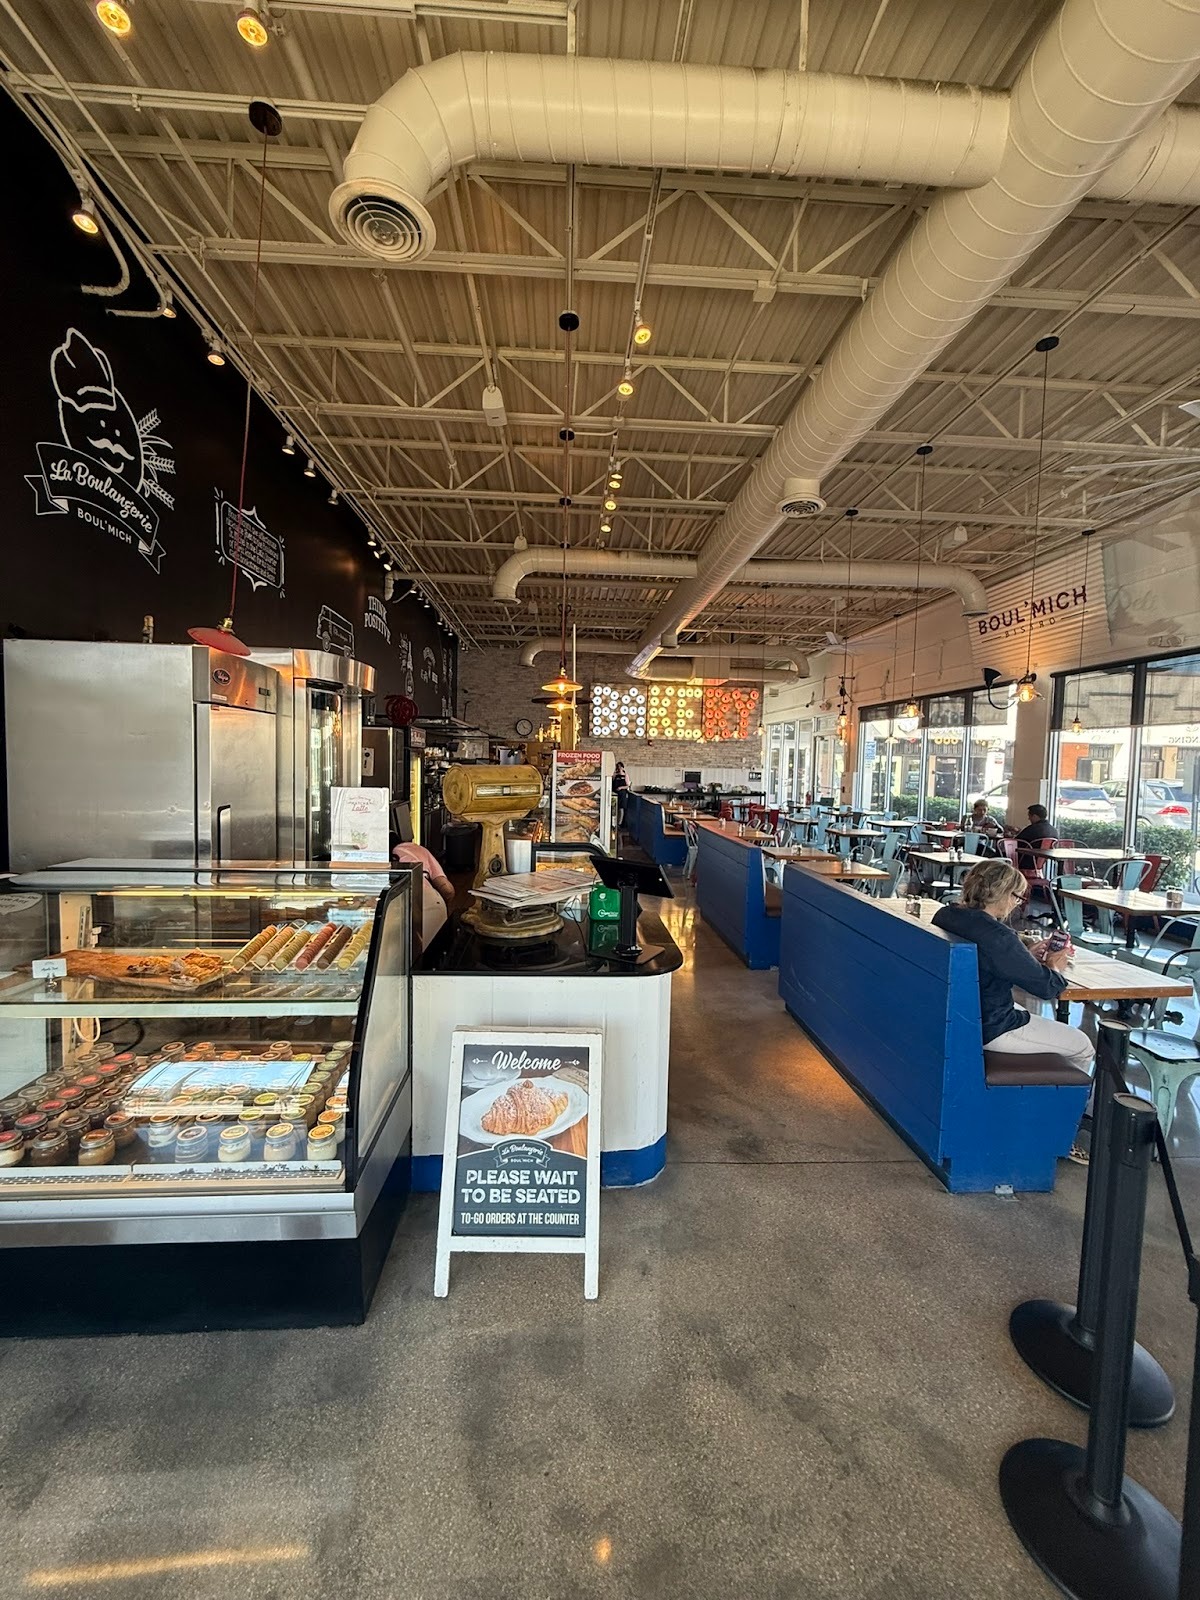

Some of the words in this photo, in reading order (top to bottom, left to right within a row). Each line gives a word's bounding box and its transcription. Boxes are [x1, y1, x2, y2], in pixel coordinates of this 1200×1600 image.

[50, 459, 73, 481] La
[72, 461, 153, 533] Boulangerie
[77, 507, 132, 545] BOUL'MICH
[368, 596, 388, 623] THINK
[978, 585, 1087, 635] BOUL'MICH
[364, 613, 391, 644] POSITIVE
[1004, 617, 1056, 638] BISTRO
[592, 685, 760, 740] BAKERY
[491, 1050, 562, 1071] Welcome
[510, 1144, 544, 1155] Boulangerie
[466, 1170, 530, 1185] PLEASE
[534, 1170, 578, 1185] WAIT
[461, 1188, 486, 1203] TO
[489, 1188, 512, 1203] BE
[515, 1189, 581, 1204] SEATED
[461, 1212, 485, 1224] TO-GO
[485, 1212, 516, 1224] ORDERS
[517, 1212, 528, 1224] AT
[528, 1212, 543, 1224] THE
[544, 1212, 580, 1225] COUNTER
